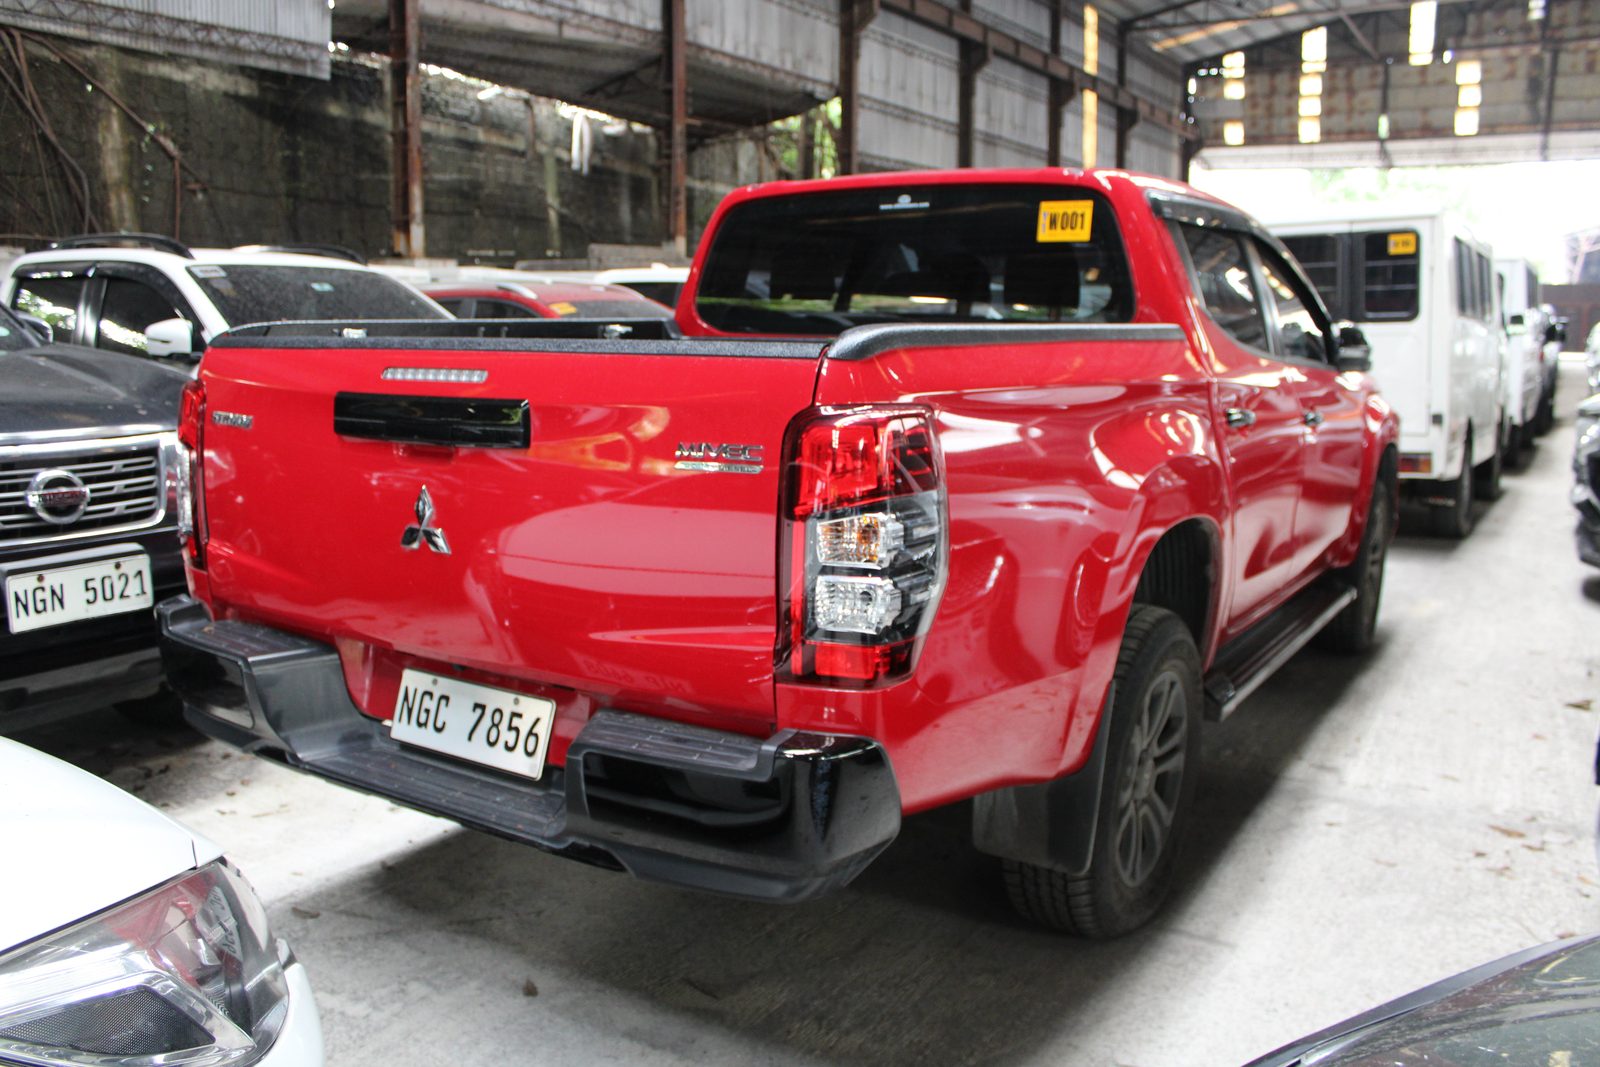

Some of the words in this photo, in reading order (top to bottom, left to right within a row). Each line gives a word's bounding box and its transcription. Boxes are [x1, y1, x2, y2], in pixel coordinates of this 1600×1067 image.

[675, 442, 763, 461] MIVEC
[14, 583, 65, 618] NGN
[84, 570, 147, 605] 5021
[398, 685, 450, 733] NGC
[467, 702, 541, 758] 7856
